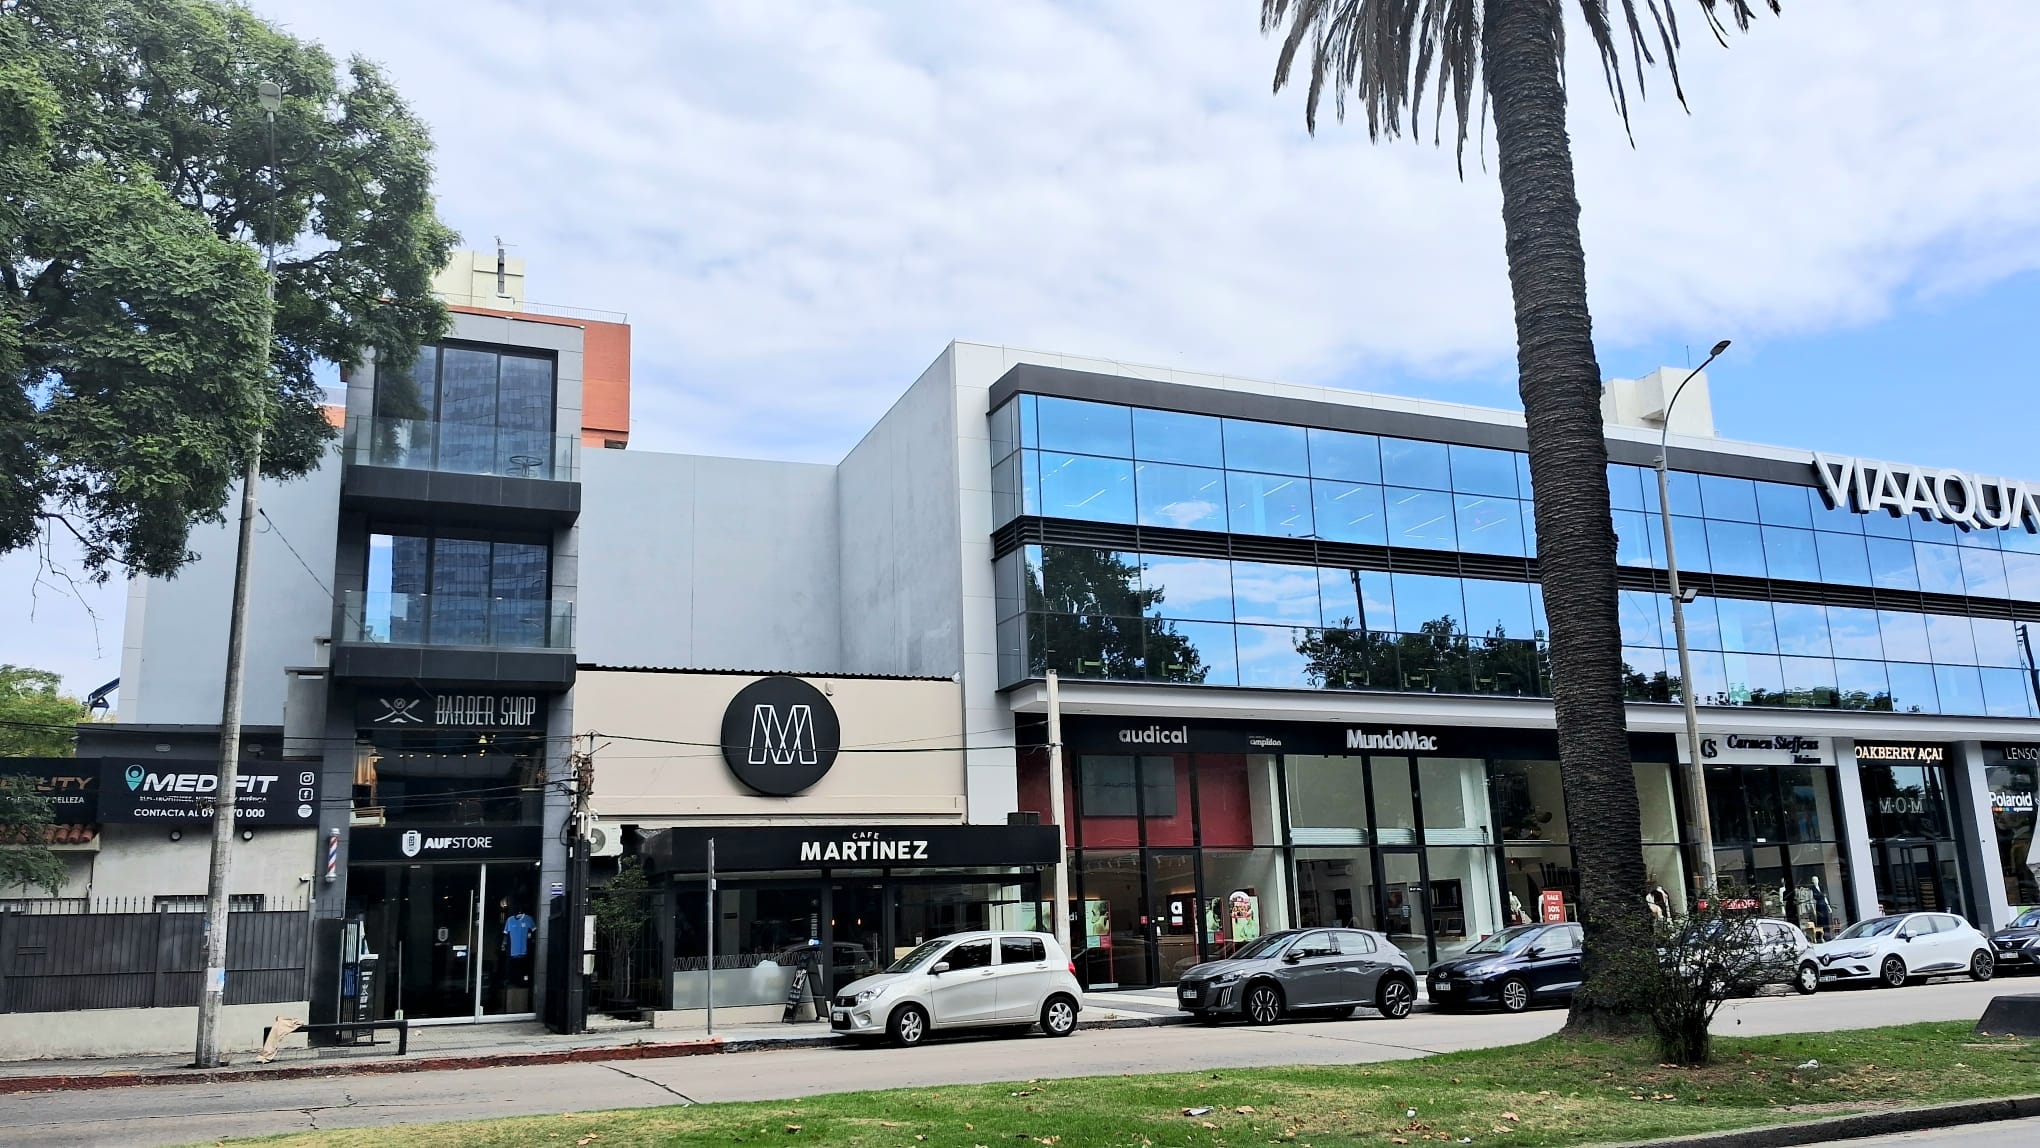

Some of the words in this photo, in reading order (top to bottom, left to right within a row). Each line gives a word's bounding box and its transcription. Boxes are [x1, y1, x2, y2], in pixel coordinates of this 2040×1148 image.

[435, 695, 496, 725] BARBER
[500, 696, 536, 726] SHOP
[1118, 726, 1188, 744] audical
[1346, 728, 1438, 750] MundoMac
[1854, 746, 1916, 759] OAKBERRY
[143, 773, 278, 793] MEDFIT
[1988, 792, 2033, 807] Polaroid
[134, 808, 186, 817] CONTACTA
[187, 809, 200, 817] AL
[245, 808, 266, 818] 000
